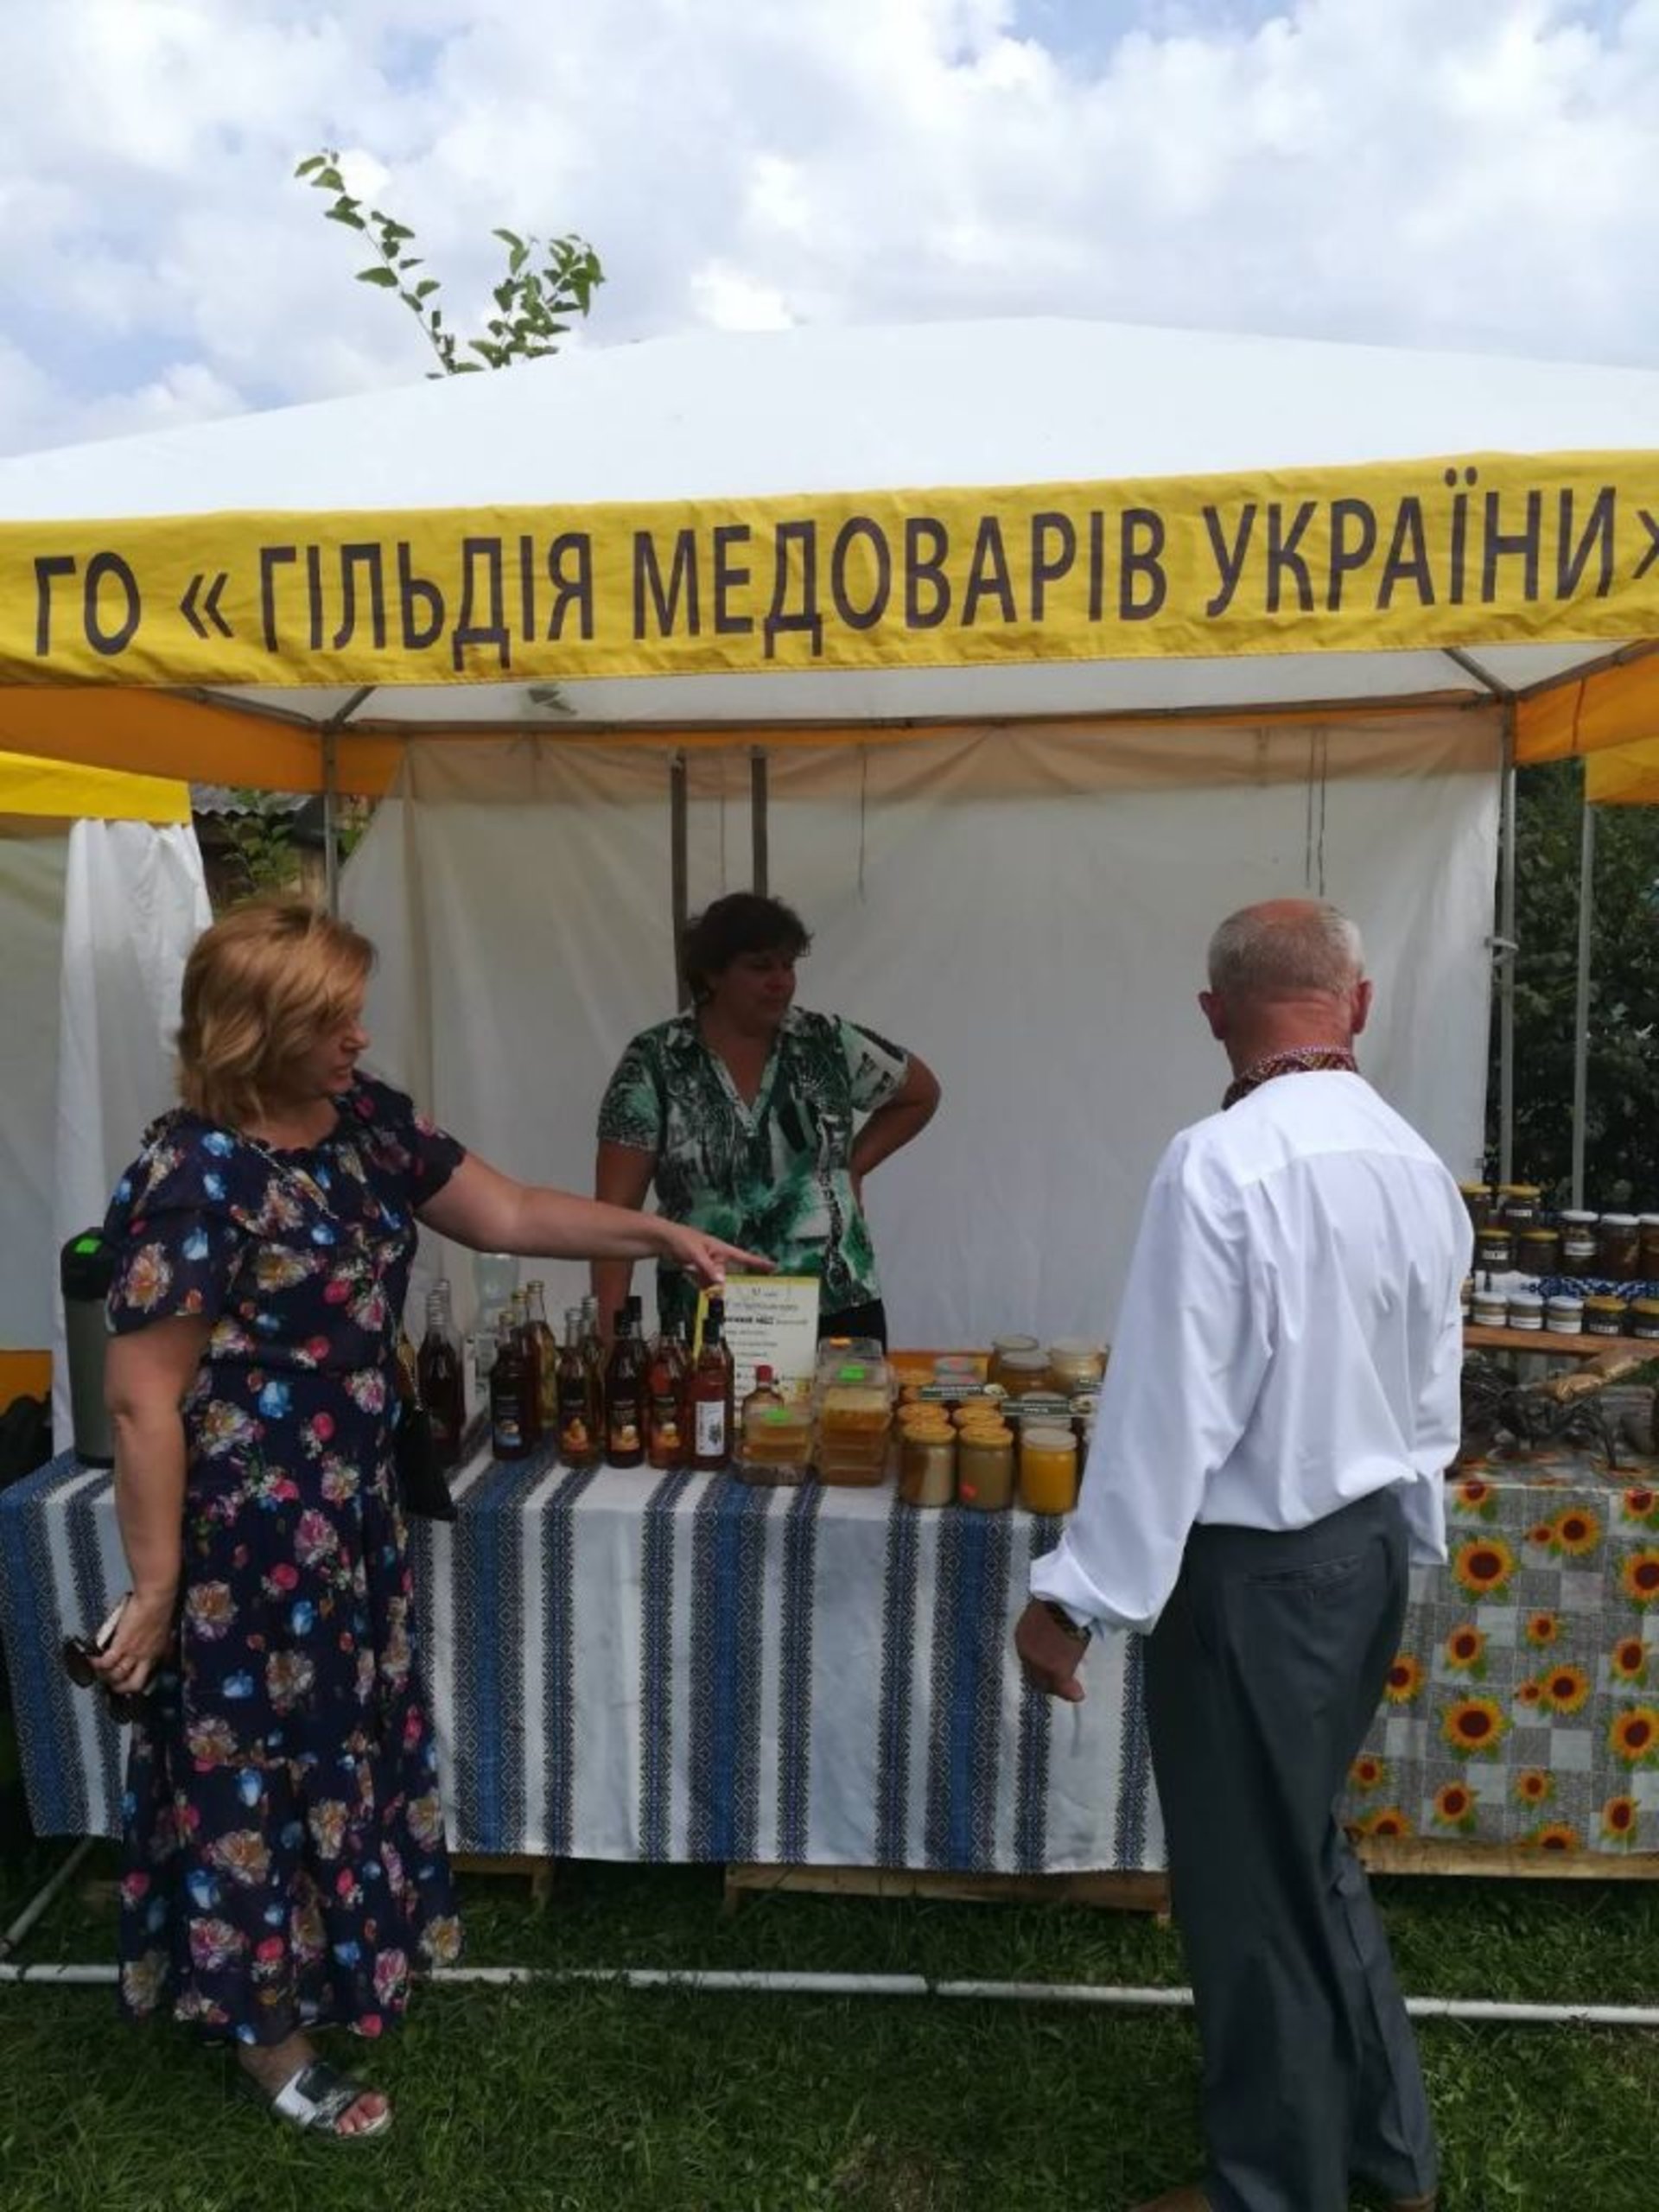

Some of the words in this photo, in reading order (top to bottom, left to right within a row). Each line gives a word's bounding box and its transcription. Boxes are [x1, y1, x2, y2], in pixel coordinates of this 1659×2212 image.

[35, 551, 140, 657] ГО
[259, 532, 594, 672] ГІЛЬДІЯ
[632, 507, 1166, 659] МЕДОВАРІВ
